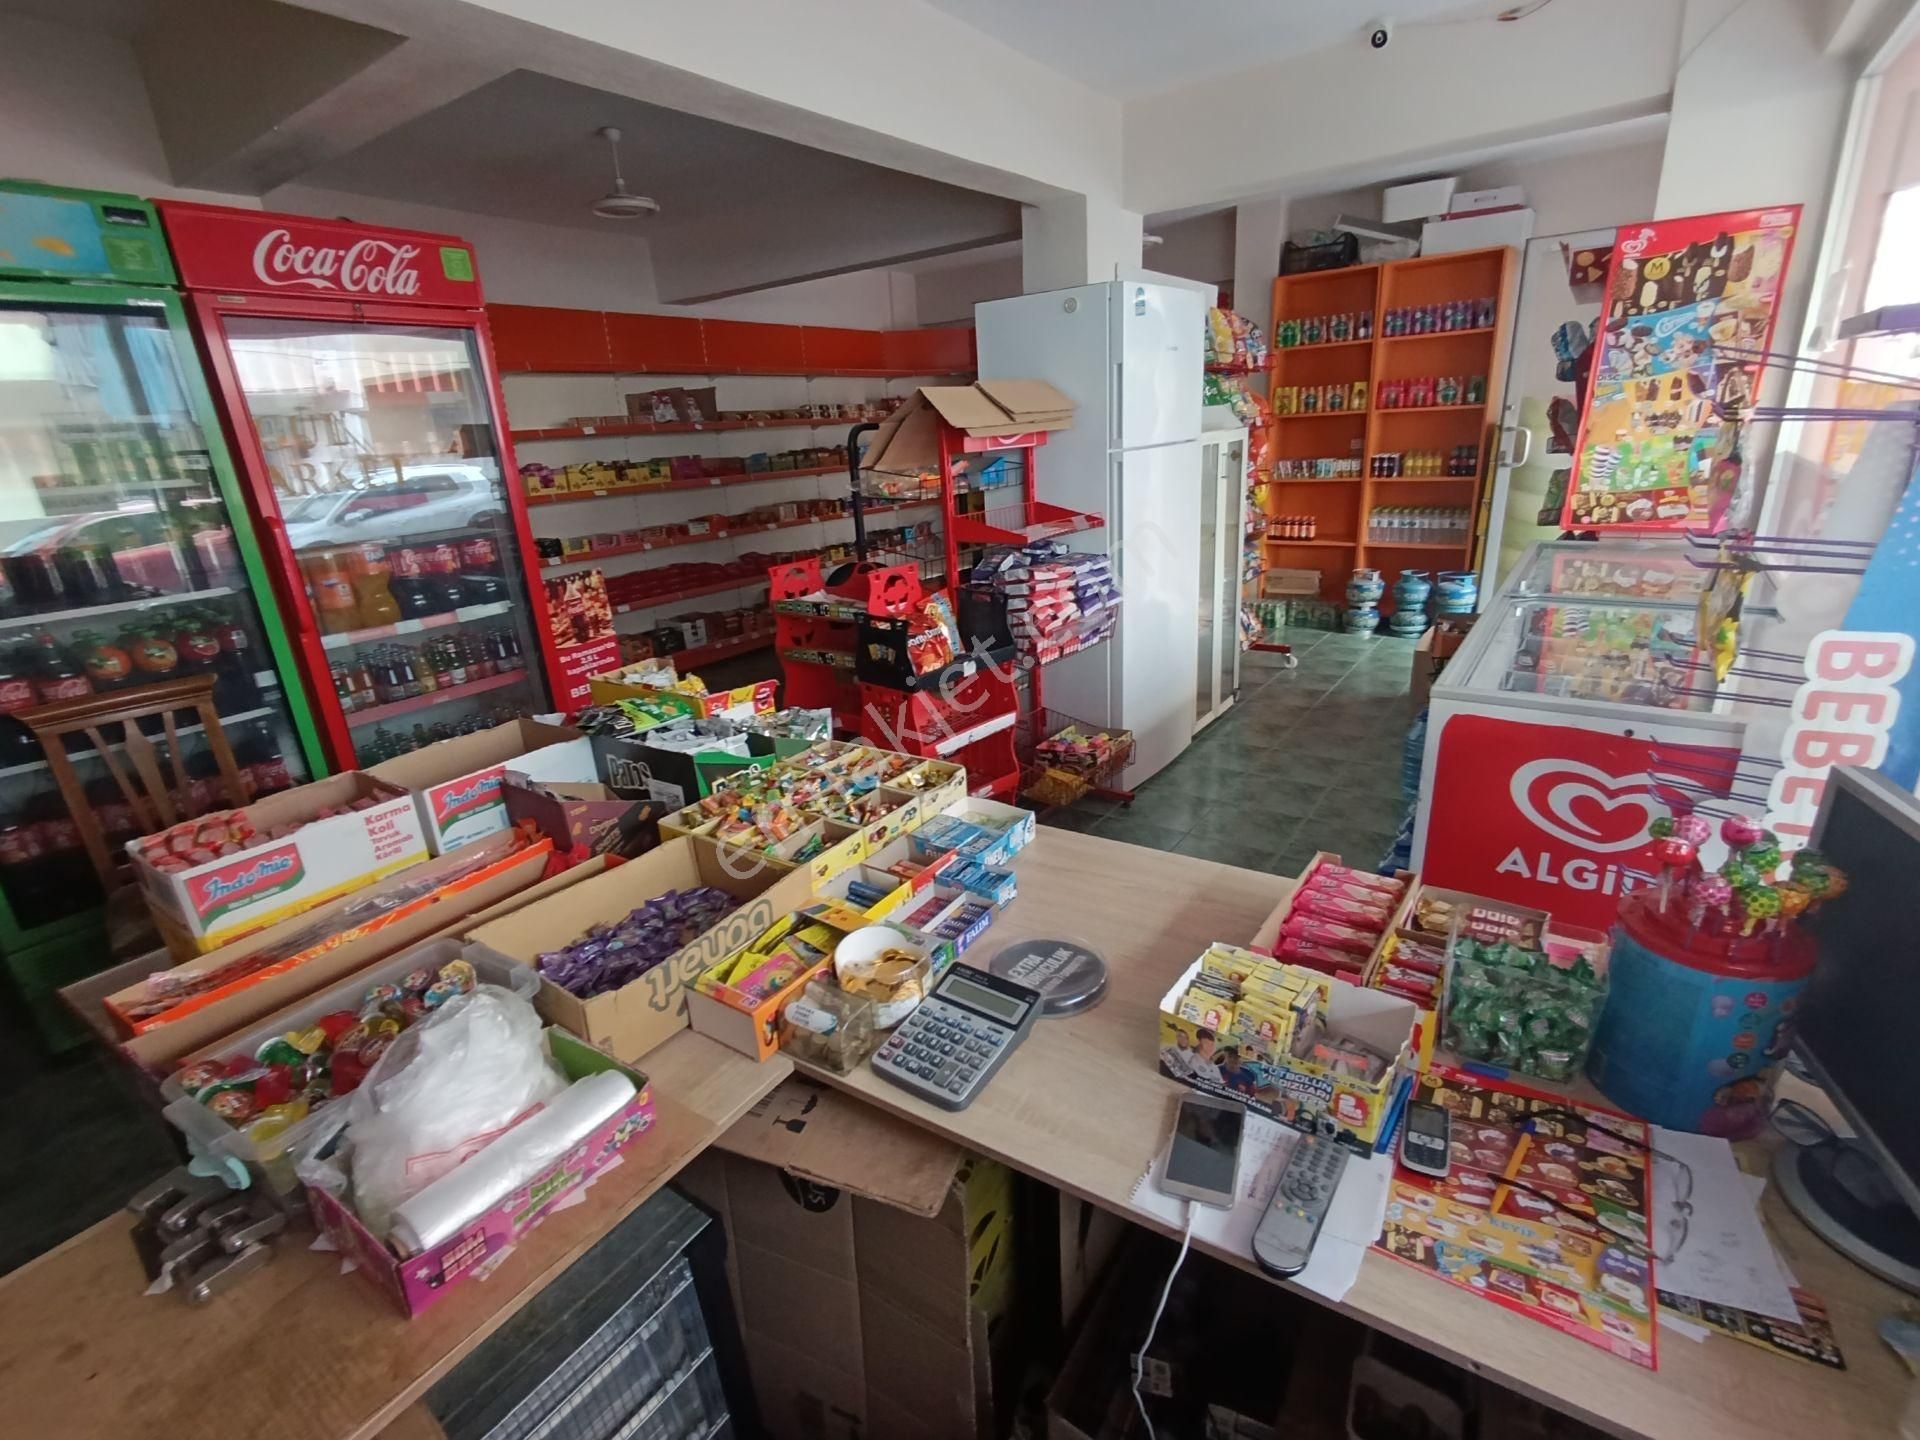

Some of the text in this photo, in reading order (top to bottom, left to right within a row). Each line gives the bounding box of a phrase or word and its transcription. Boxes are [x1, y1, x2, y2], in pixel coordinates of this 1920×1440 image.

[253, 229, 421, 296] Coca-Cola
[1765, 639, 1902, 880] BEBE
[364, 804, 412, 827] Karma
[367, 819, 395, 838] Koli
[1496, 846, 1658, 897] ALGİ
[1007, 953, 1044, 979] EXTRA
